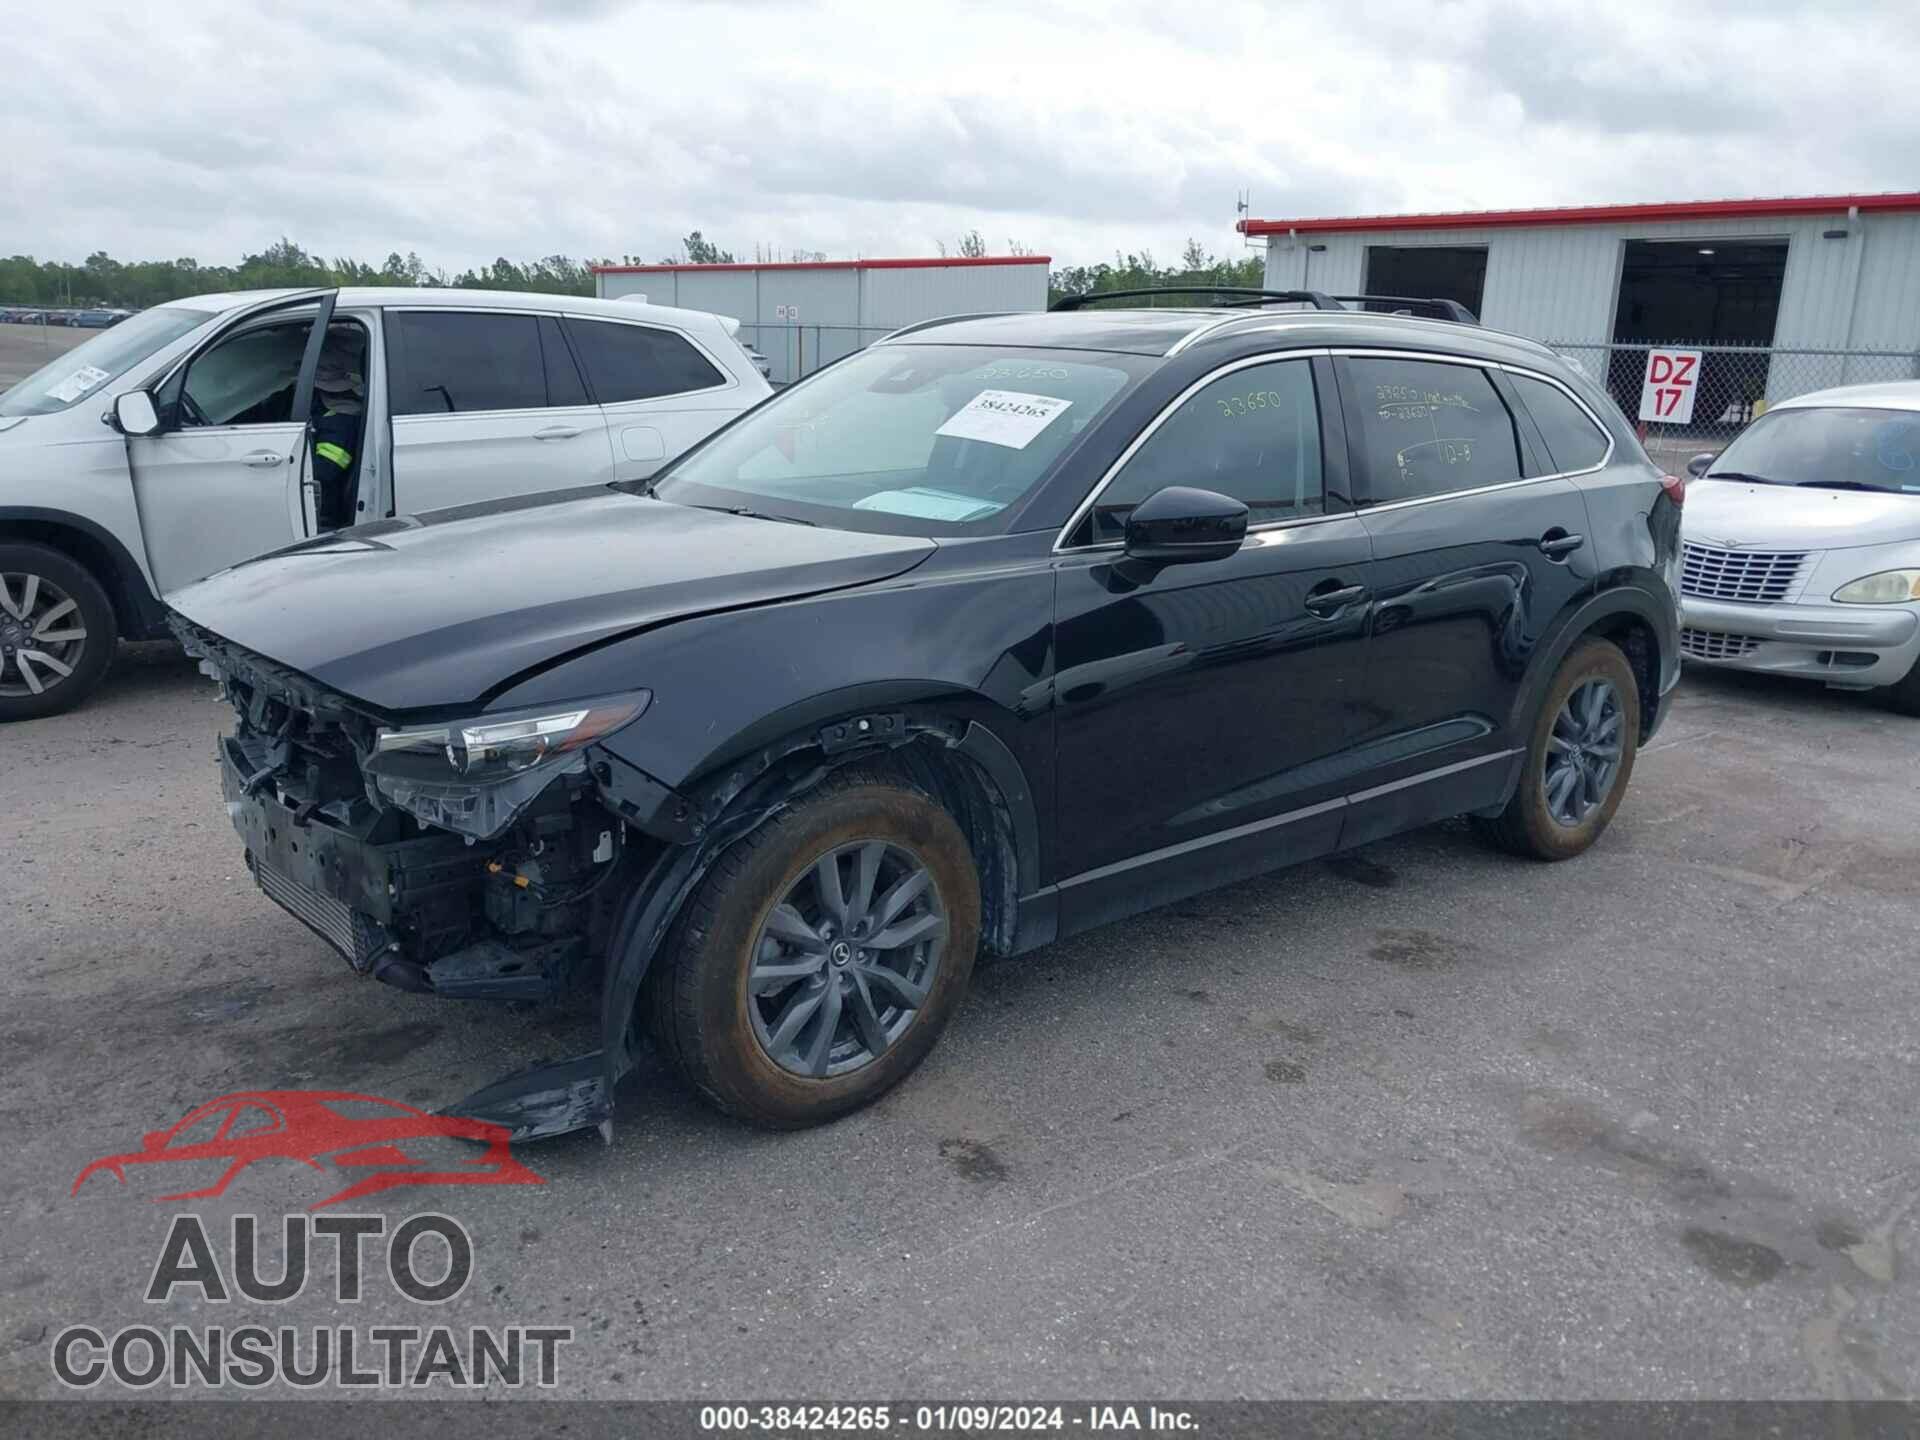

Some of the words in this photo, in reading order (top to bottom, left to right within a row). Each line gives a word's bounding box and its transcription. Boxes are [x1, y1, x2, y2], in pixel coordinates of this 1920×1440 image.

[1650, 355, 1696, 385] DZ
[974, 400, 1049, 418] 38424265
[1216, 391, 1281, 417] 23650
[1655, 388, 1682, 416] 17
